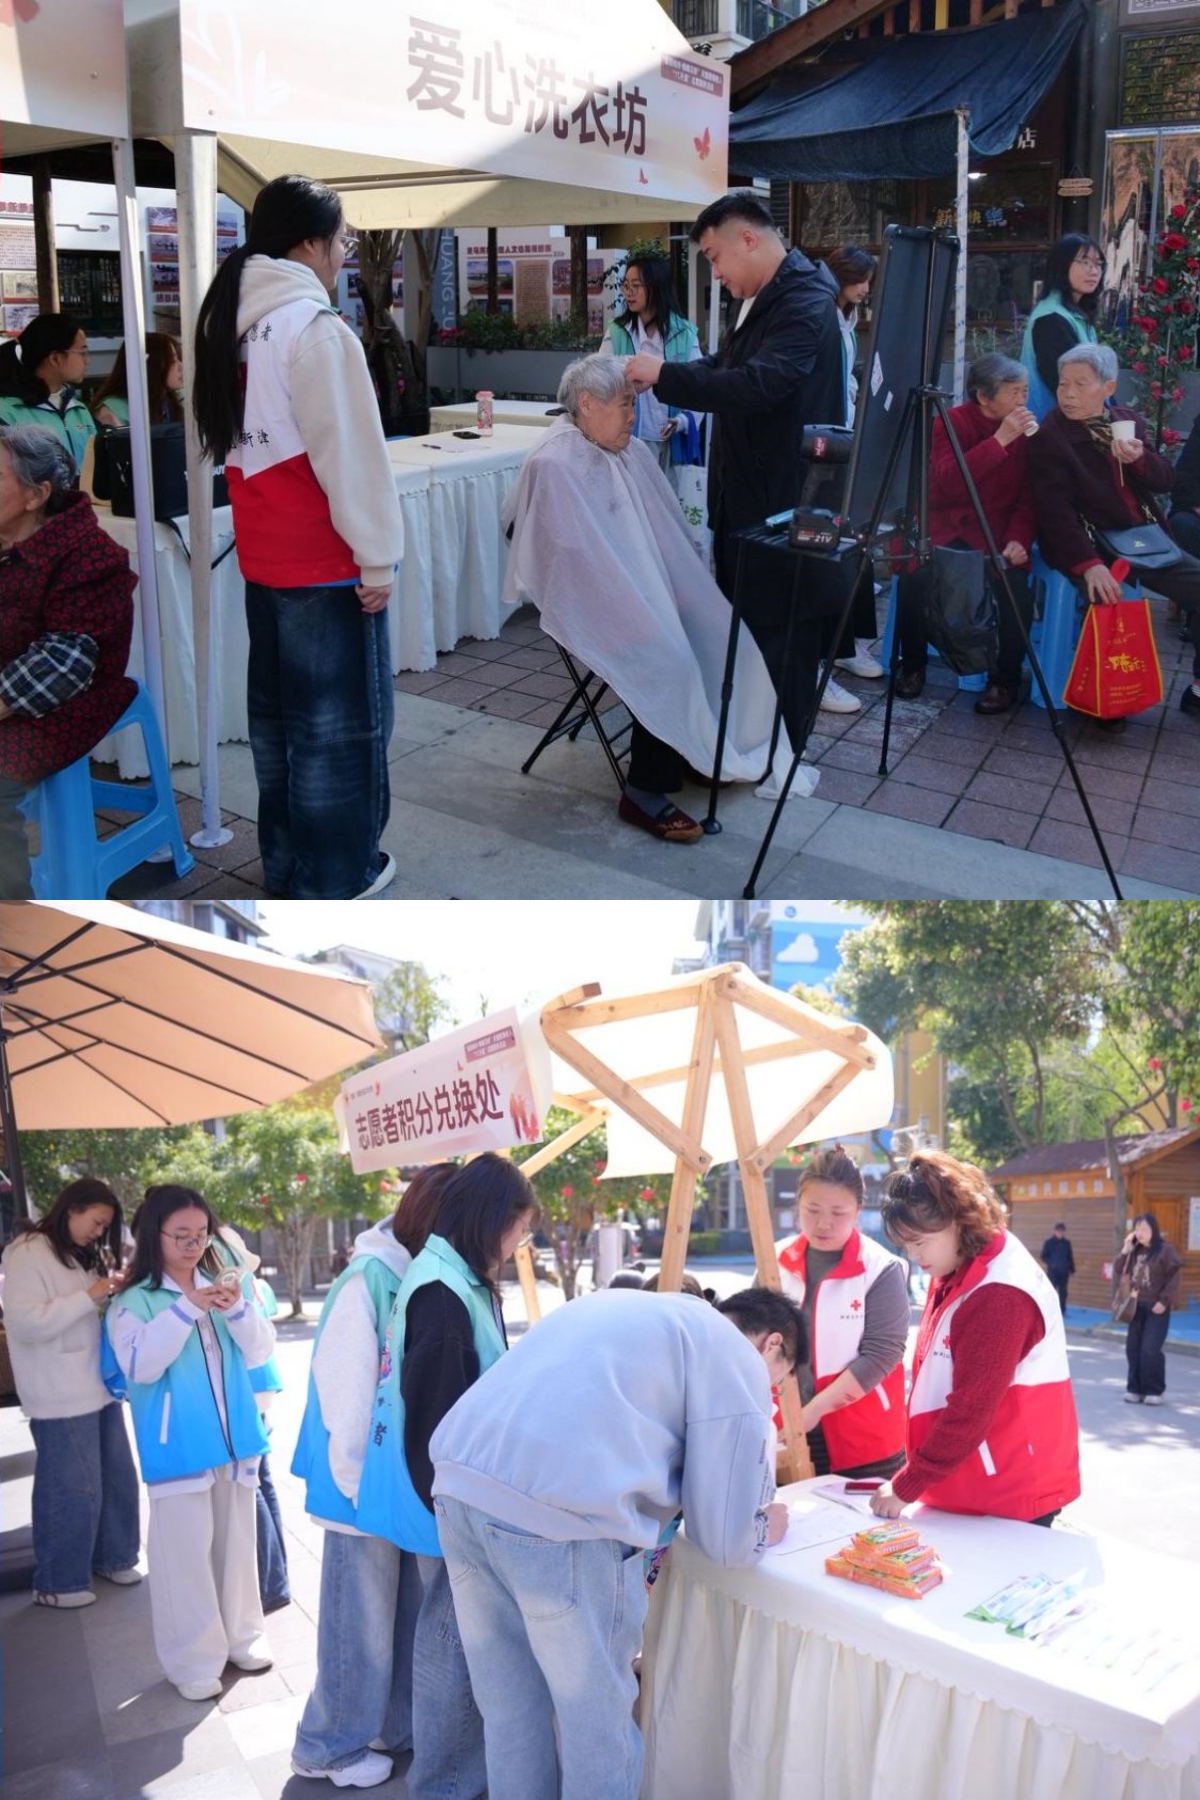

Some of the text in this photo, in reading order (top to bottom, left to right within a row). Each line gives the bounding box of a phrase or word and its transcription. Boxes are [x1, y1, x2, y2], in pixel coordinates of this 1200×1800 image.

[406, 16, 648, 155] 爱心洗衣坊
[814, 534, 832, 543] 21V
[355, 1069, 504, 1150] 志愿者积分兑换处
